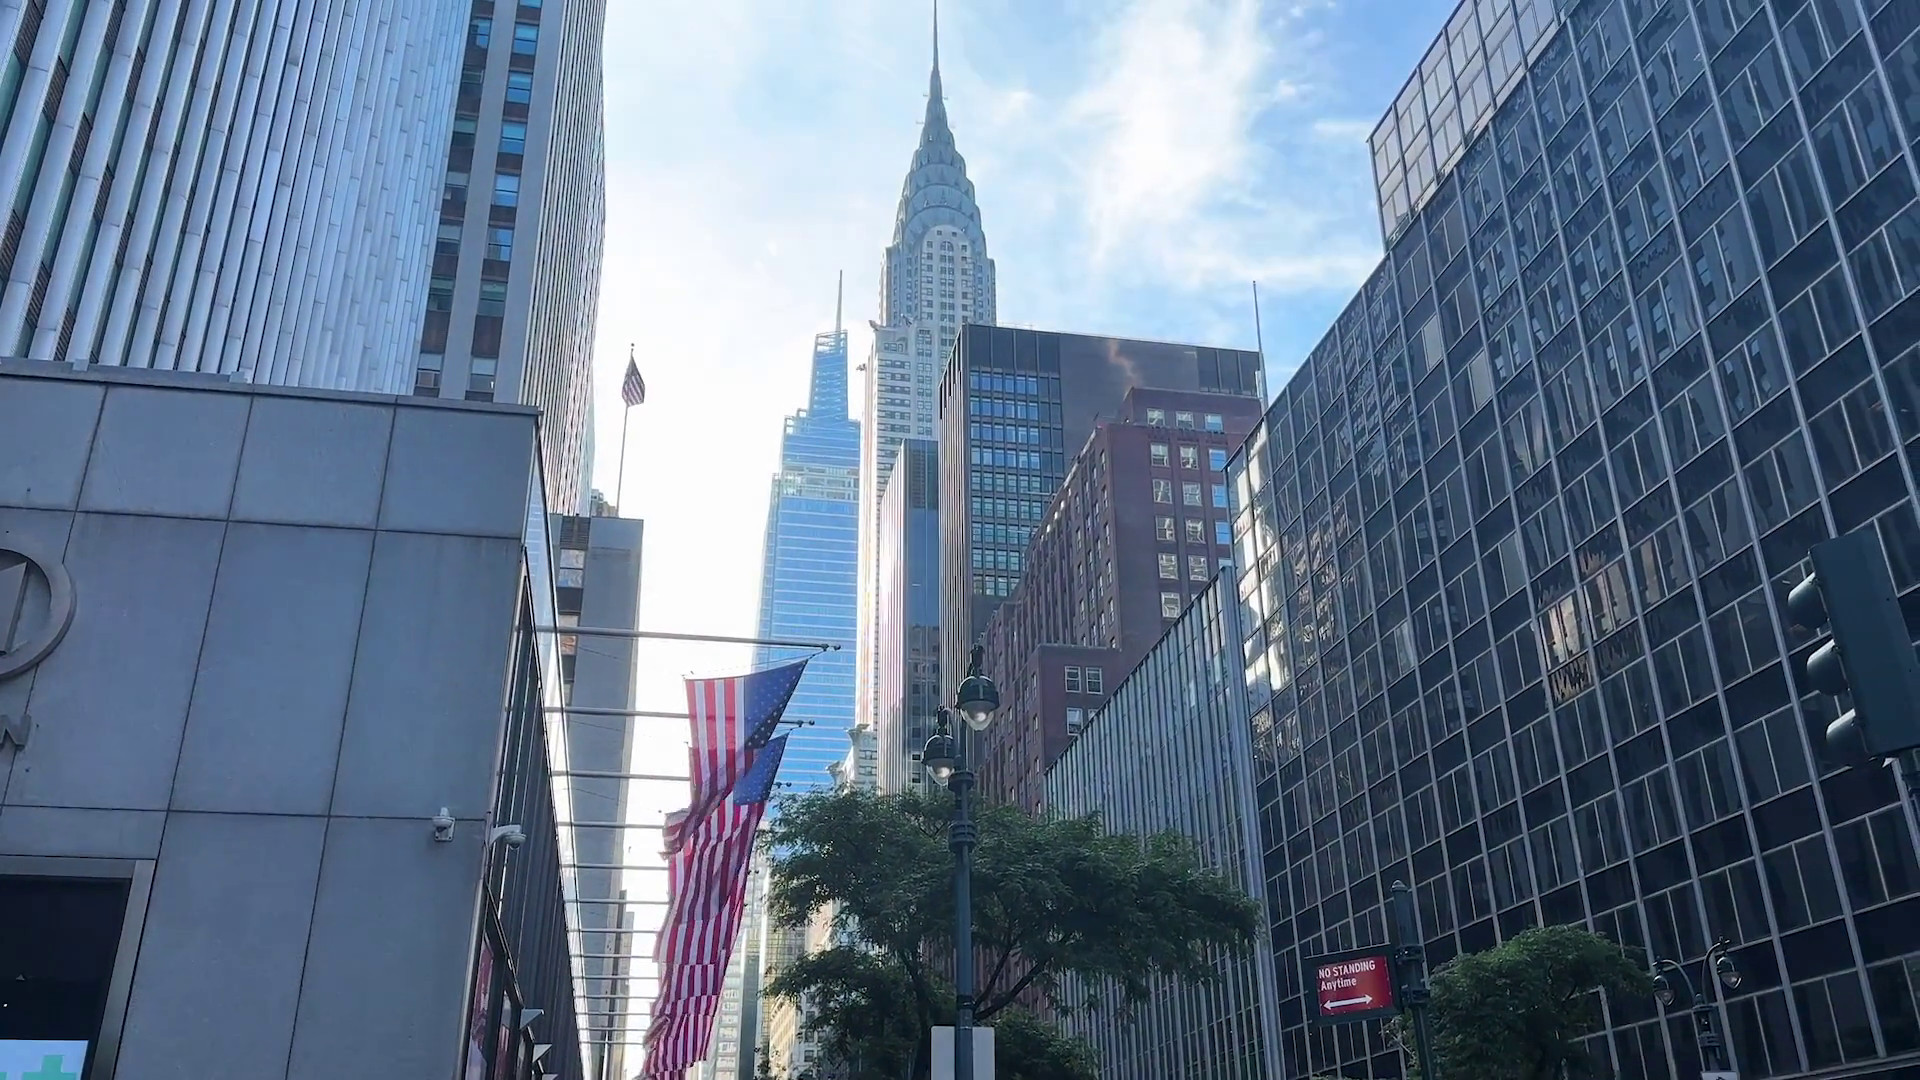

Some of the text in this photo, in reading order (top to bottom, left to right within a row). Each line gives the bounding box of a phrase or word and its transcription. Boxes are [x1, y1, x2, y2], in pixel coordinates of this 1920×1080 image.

[1318, 960, 1376, 979] NO STANDING
[1321, 978, 1357, 992] Anytime
